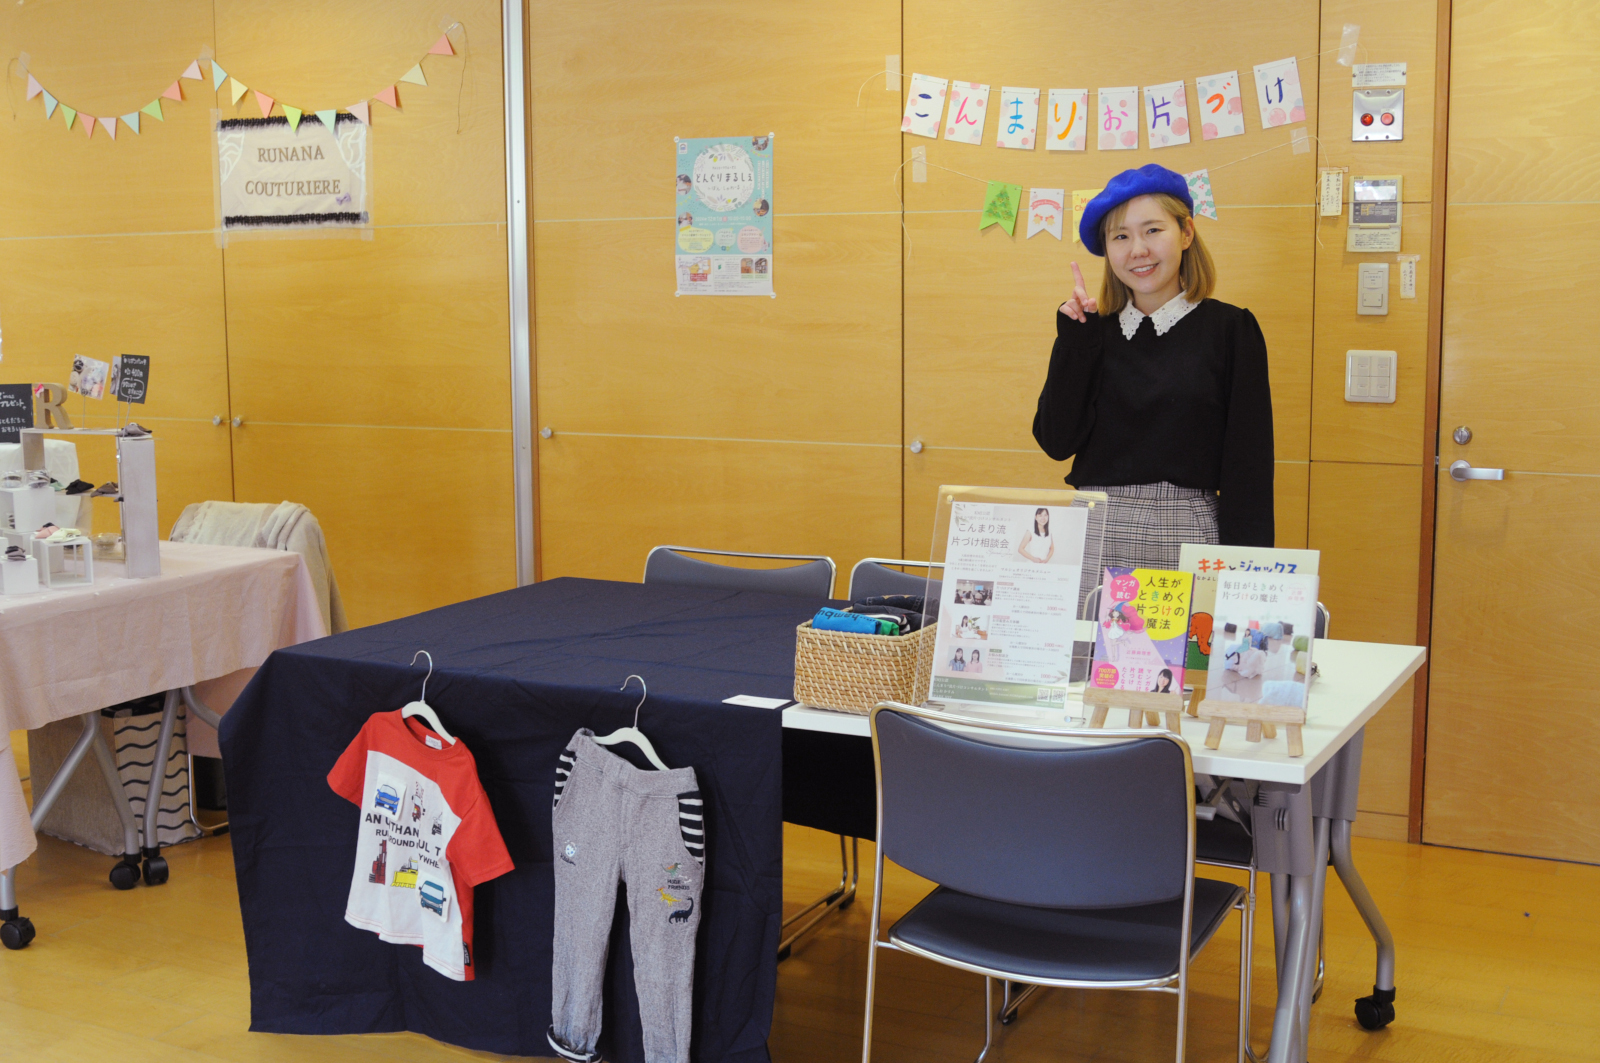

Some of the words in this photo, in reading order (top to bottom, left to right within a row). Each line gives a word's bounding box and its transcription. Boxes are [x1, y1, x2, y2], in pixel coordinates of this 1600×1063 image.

[915, 77, 1284, 140] こんまりお片づけ
[257, 145, 325, 163] RUNANA
[696, 172, 753, 183] どんぐりまるしぇ
[245, 179, 341, 197] COUTURIERE
[33, 383, 74, 429] R
[958, 523, 1007, 535] こんまり流
[951, 536, 1010, 550] 片づけ相談会
[1115, 579, 1136, 587] マンガ
[1145, 576, 1182, 588] 人生が
[1223, 580, 1285, 592] 毎日がときめく
[1115, 591, 1131, 600] 読む
[1138, 590, 1185, 603] ときめく
[1222, 592, 1279, 604] 片づけの魔法
[1136, 604, 1185, 617] 片づけの
[1146, 618, 1171, 630] 魔法
[365, 812, 382, 825] AN
